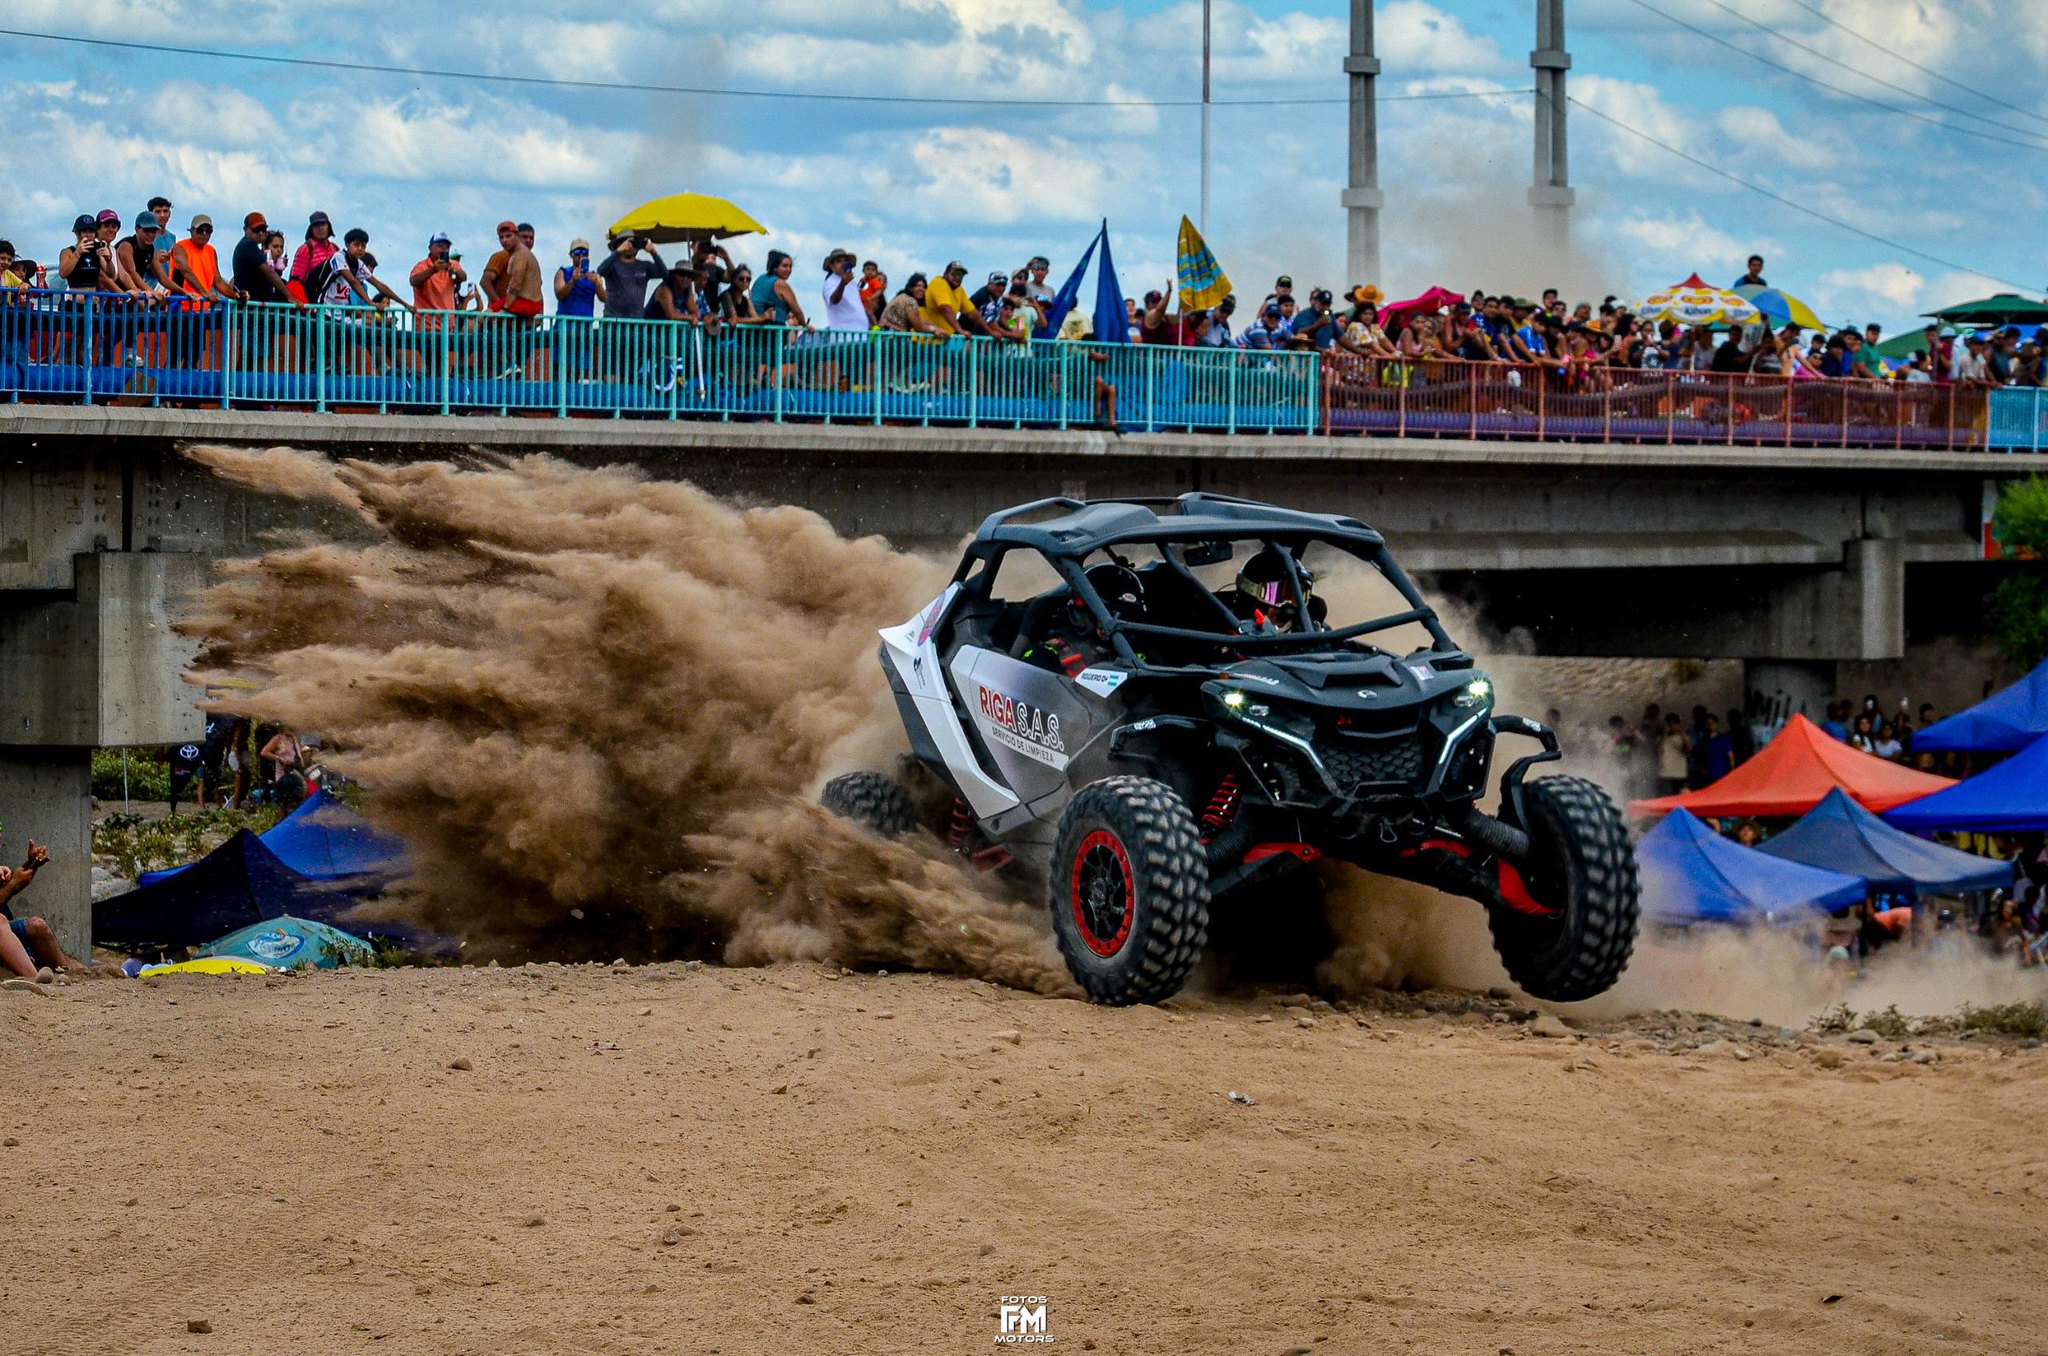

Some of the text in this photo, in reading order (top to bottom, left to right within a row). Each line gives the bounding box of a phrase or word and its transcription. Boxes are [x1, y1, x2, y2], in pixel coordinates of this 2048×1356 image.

[979, 684, 1065, 752] RIGA S.A.S.
[992, 726, 1055, 763] SERVICIO DE LIMPIEZA
